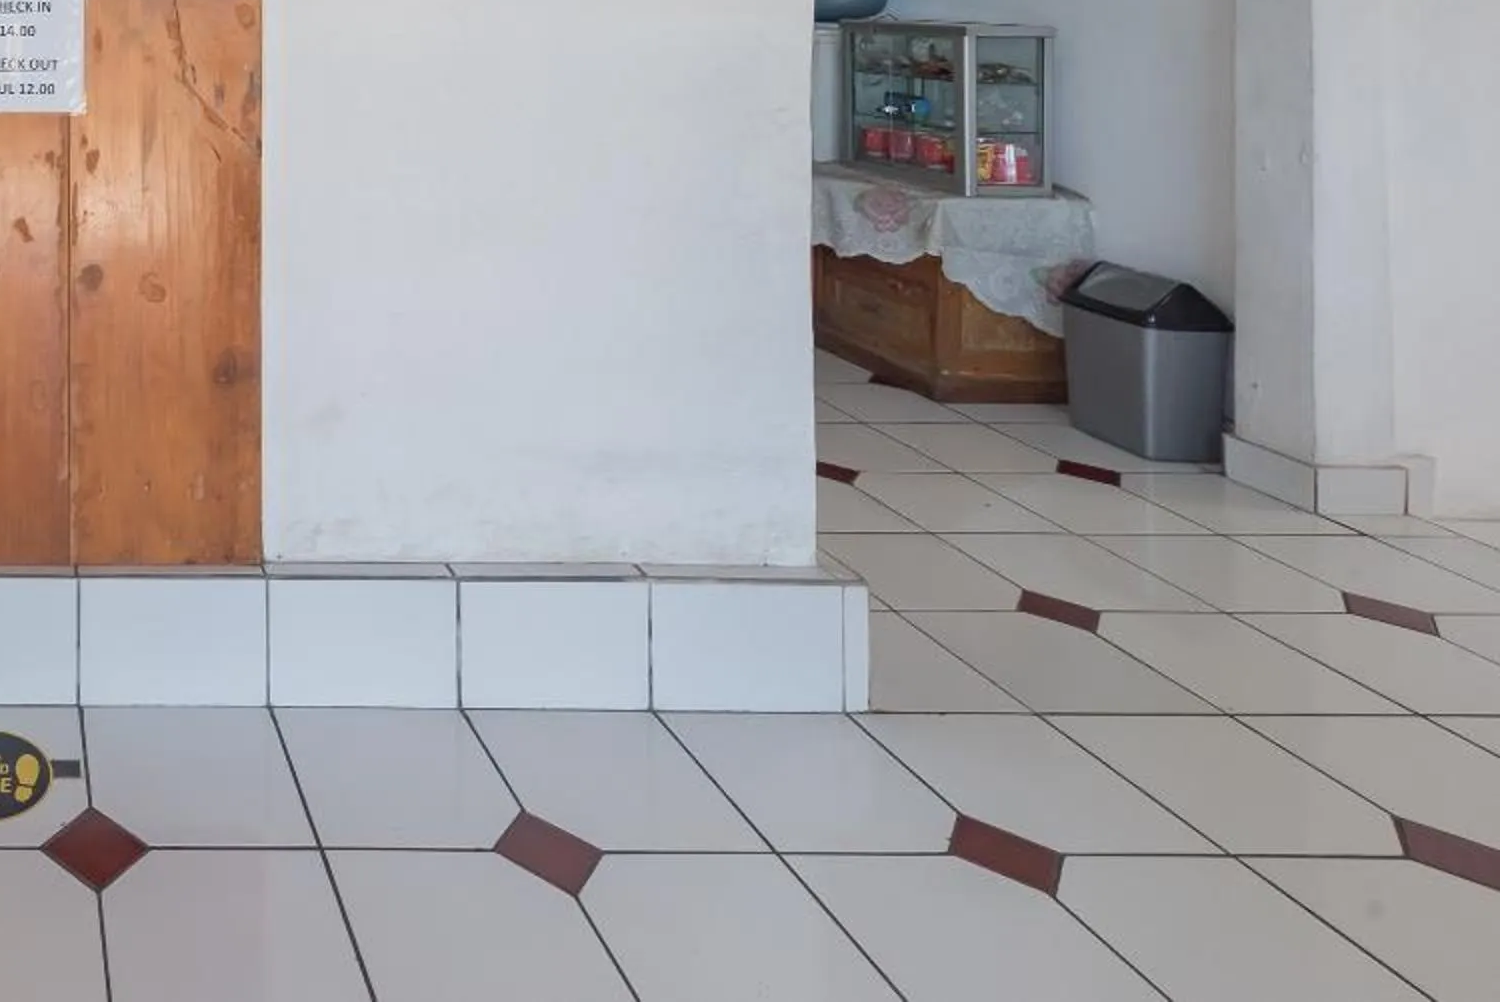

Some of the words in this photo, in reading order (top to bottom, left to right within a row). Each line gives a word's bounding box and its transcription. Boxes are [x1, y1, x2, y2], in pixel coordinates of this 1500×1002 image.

[37, 0, 52, 13] IN
[0, 25, 37, 37] 14.00
[29, 59, 59, 71] OUT
[19, 83, 55, 95] 12.00
